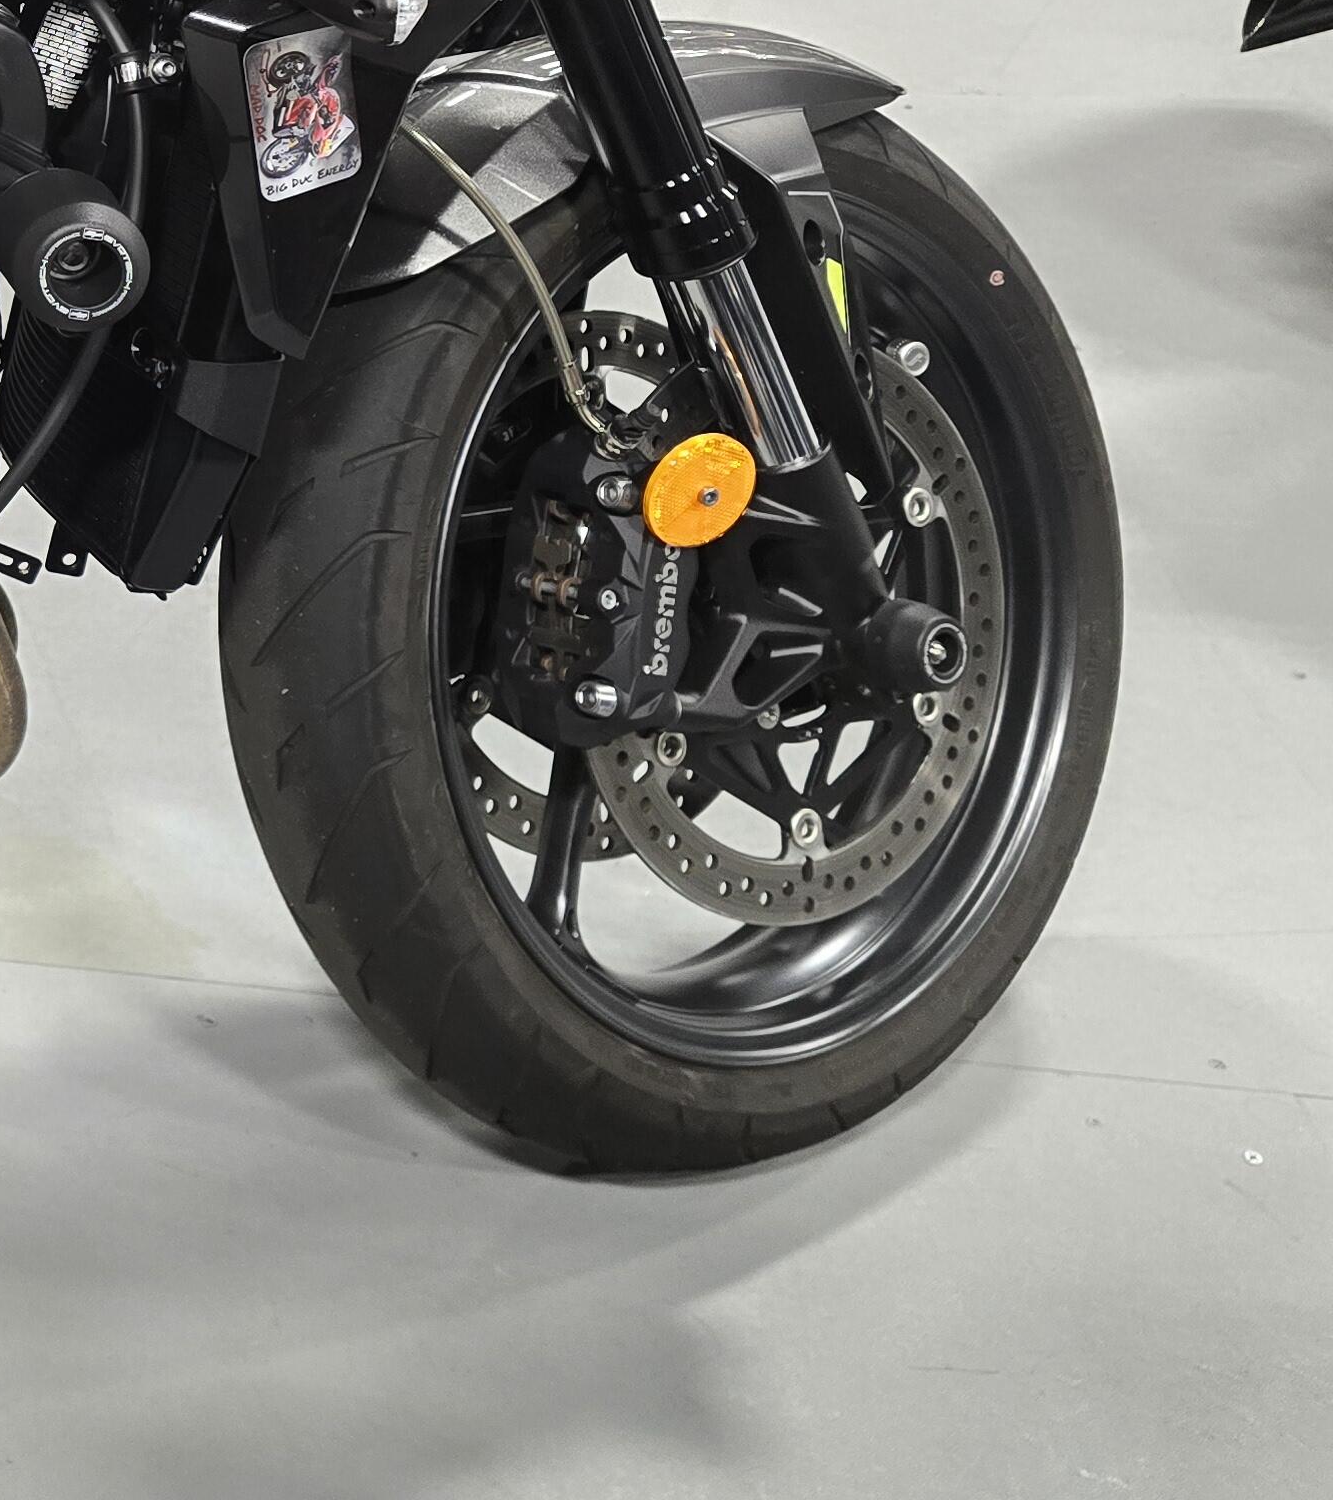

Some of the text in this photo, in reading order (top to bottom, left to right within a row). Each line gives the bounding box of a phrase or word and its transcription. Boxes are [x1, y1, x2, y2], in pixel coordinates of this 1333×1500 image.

[265, 185, 289, 197] BIG
[317, 158, 360, 179] ENERGY
[642, 543, 681, 677] brembo
